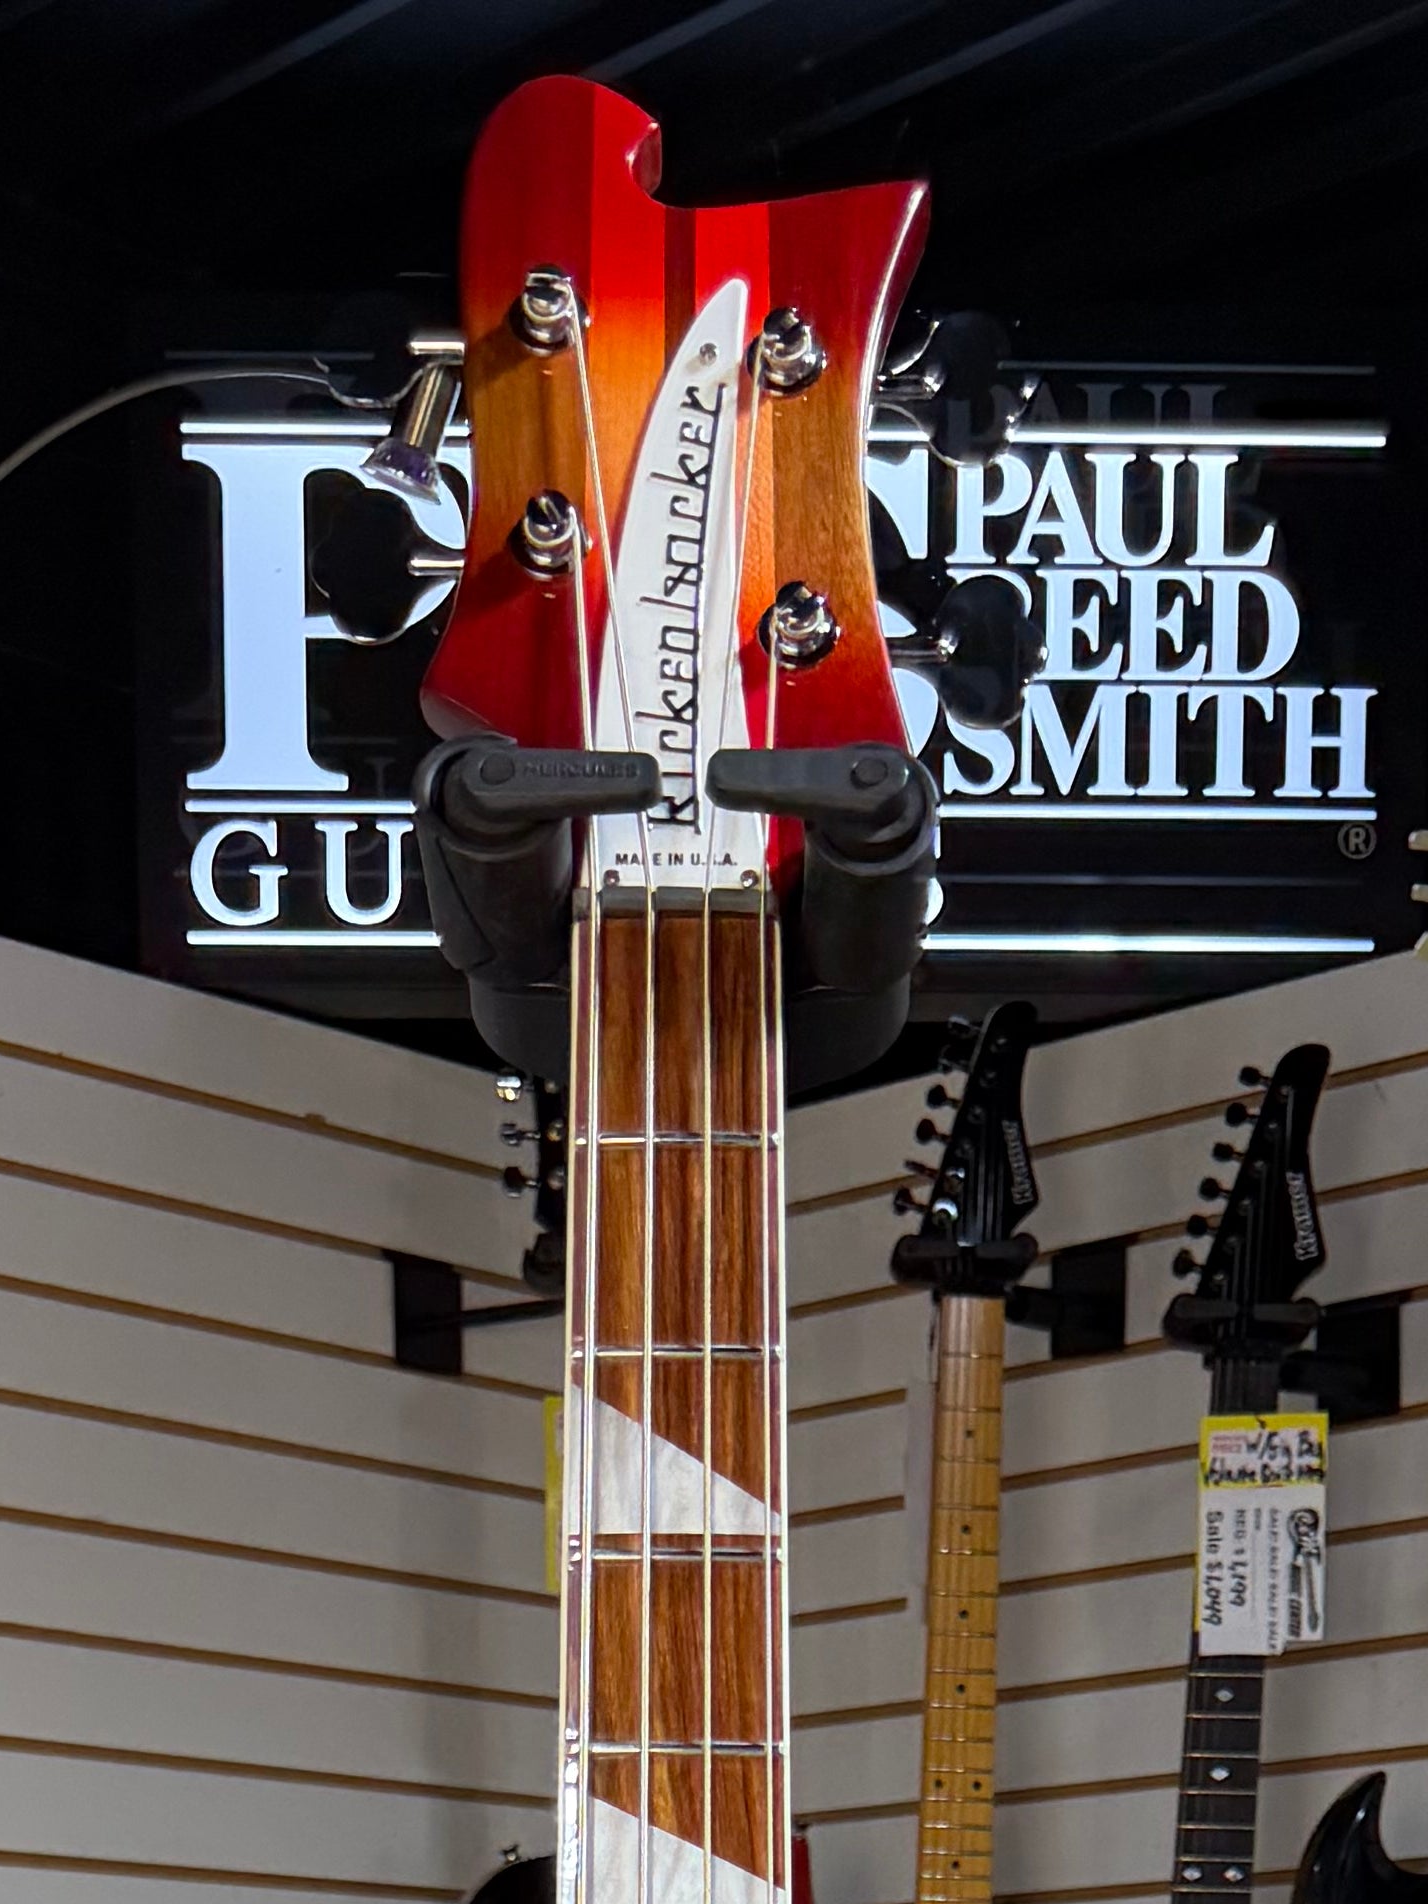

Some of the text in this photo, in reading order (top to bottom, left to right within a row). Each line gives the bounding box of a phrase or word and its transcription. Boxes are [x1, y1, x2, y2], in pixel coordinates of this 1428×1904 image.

[946, 450, 1275, 567] PAUL
[635, 382, 728, 836] Rickenbacker
[946, 568, 1300, 682] EED
[943, 683, 1378, 798] SMITH
[668, 852, 684, 866] IN
[1206, 1509, 1224, 1555] Sale
